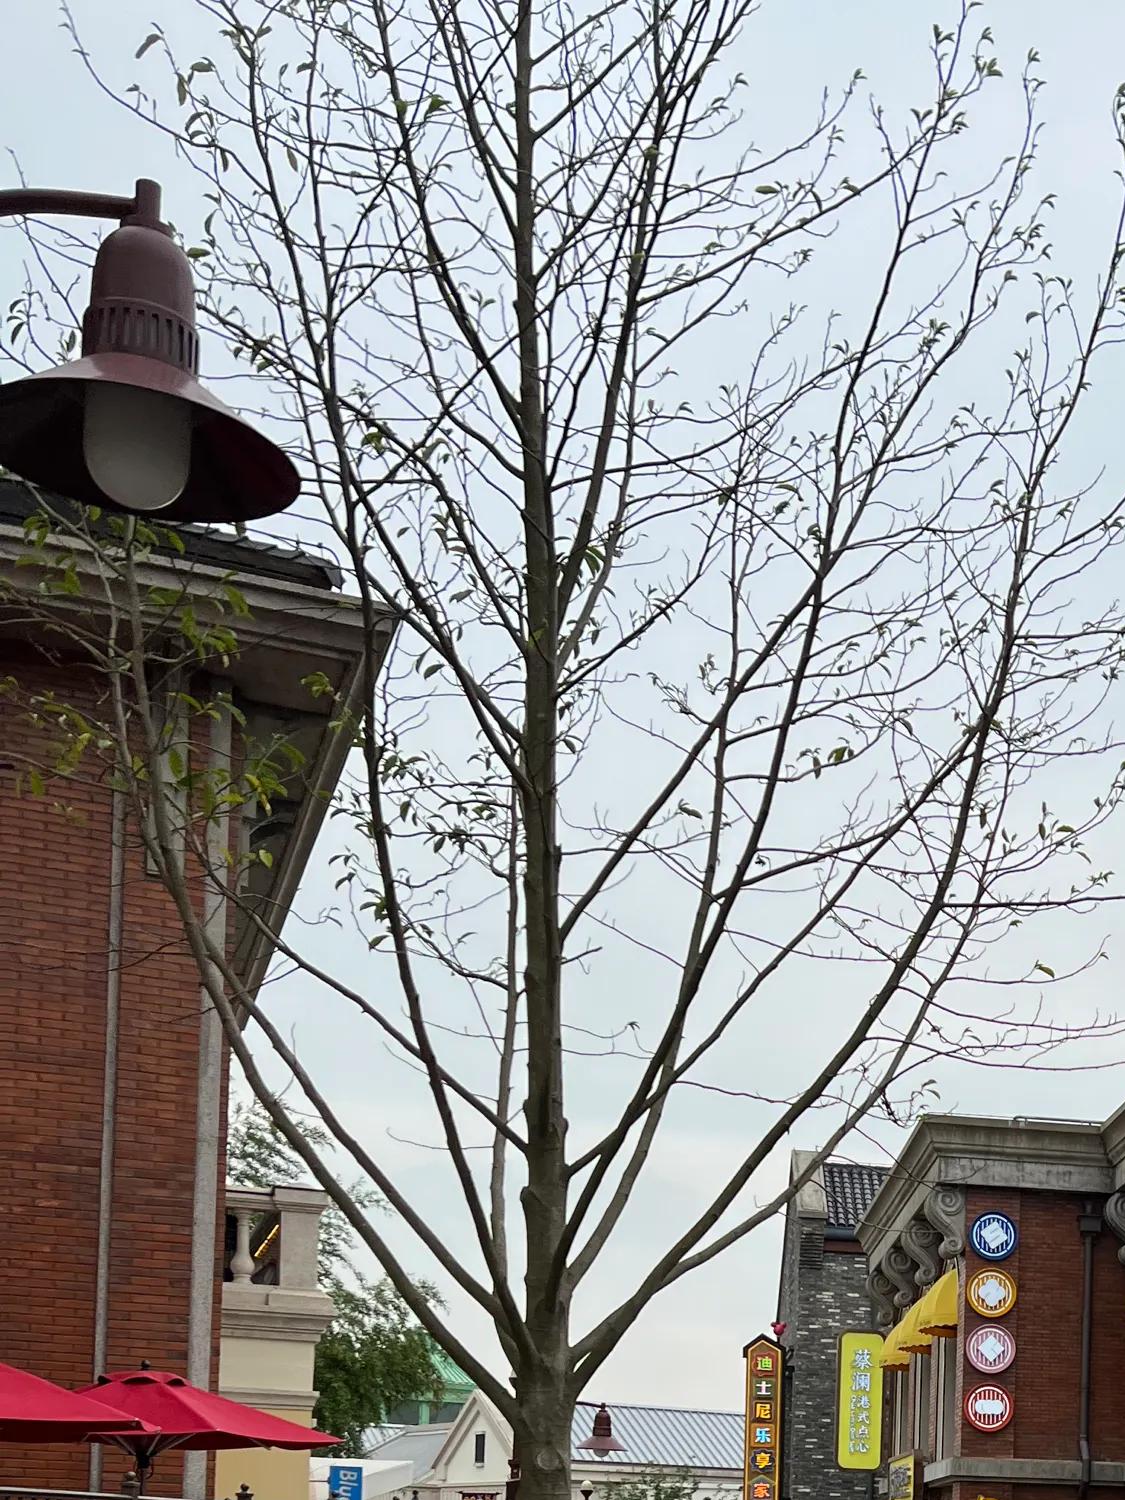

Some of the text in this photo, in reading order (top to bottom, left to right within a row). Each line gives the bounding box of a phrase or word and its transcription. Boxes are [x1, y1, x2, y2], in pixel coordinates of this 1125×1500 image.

[754, 1356, 772, 1498] 迪士尼乐享家
